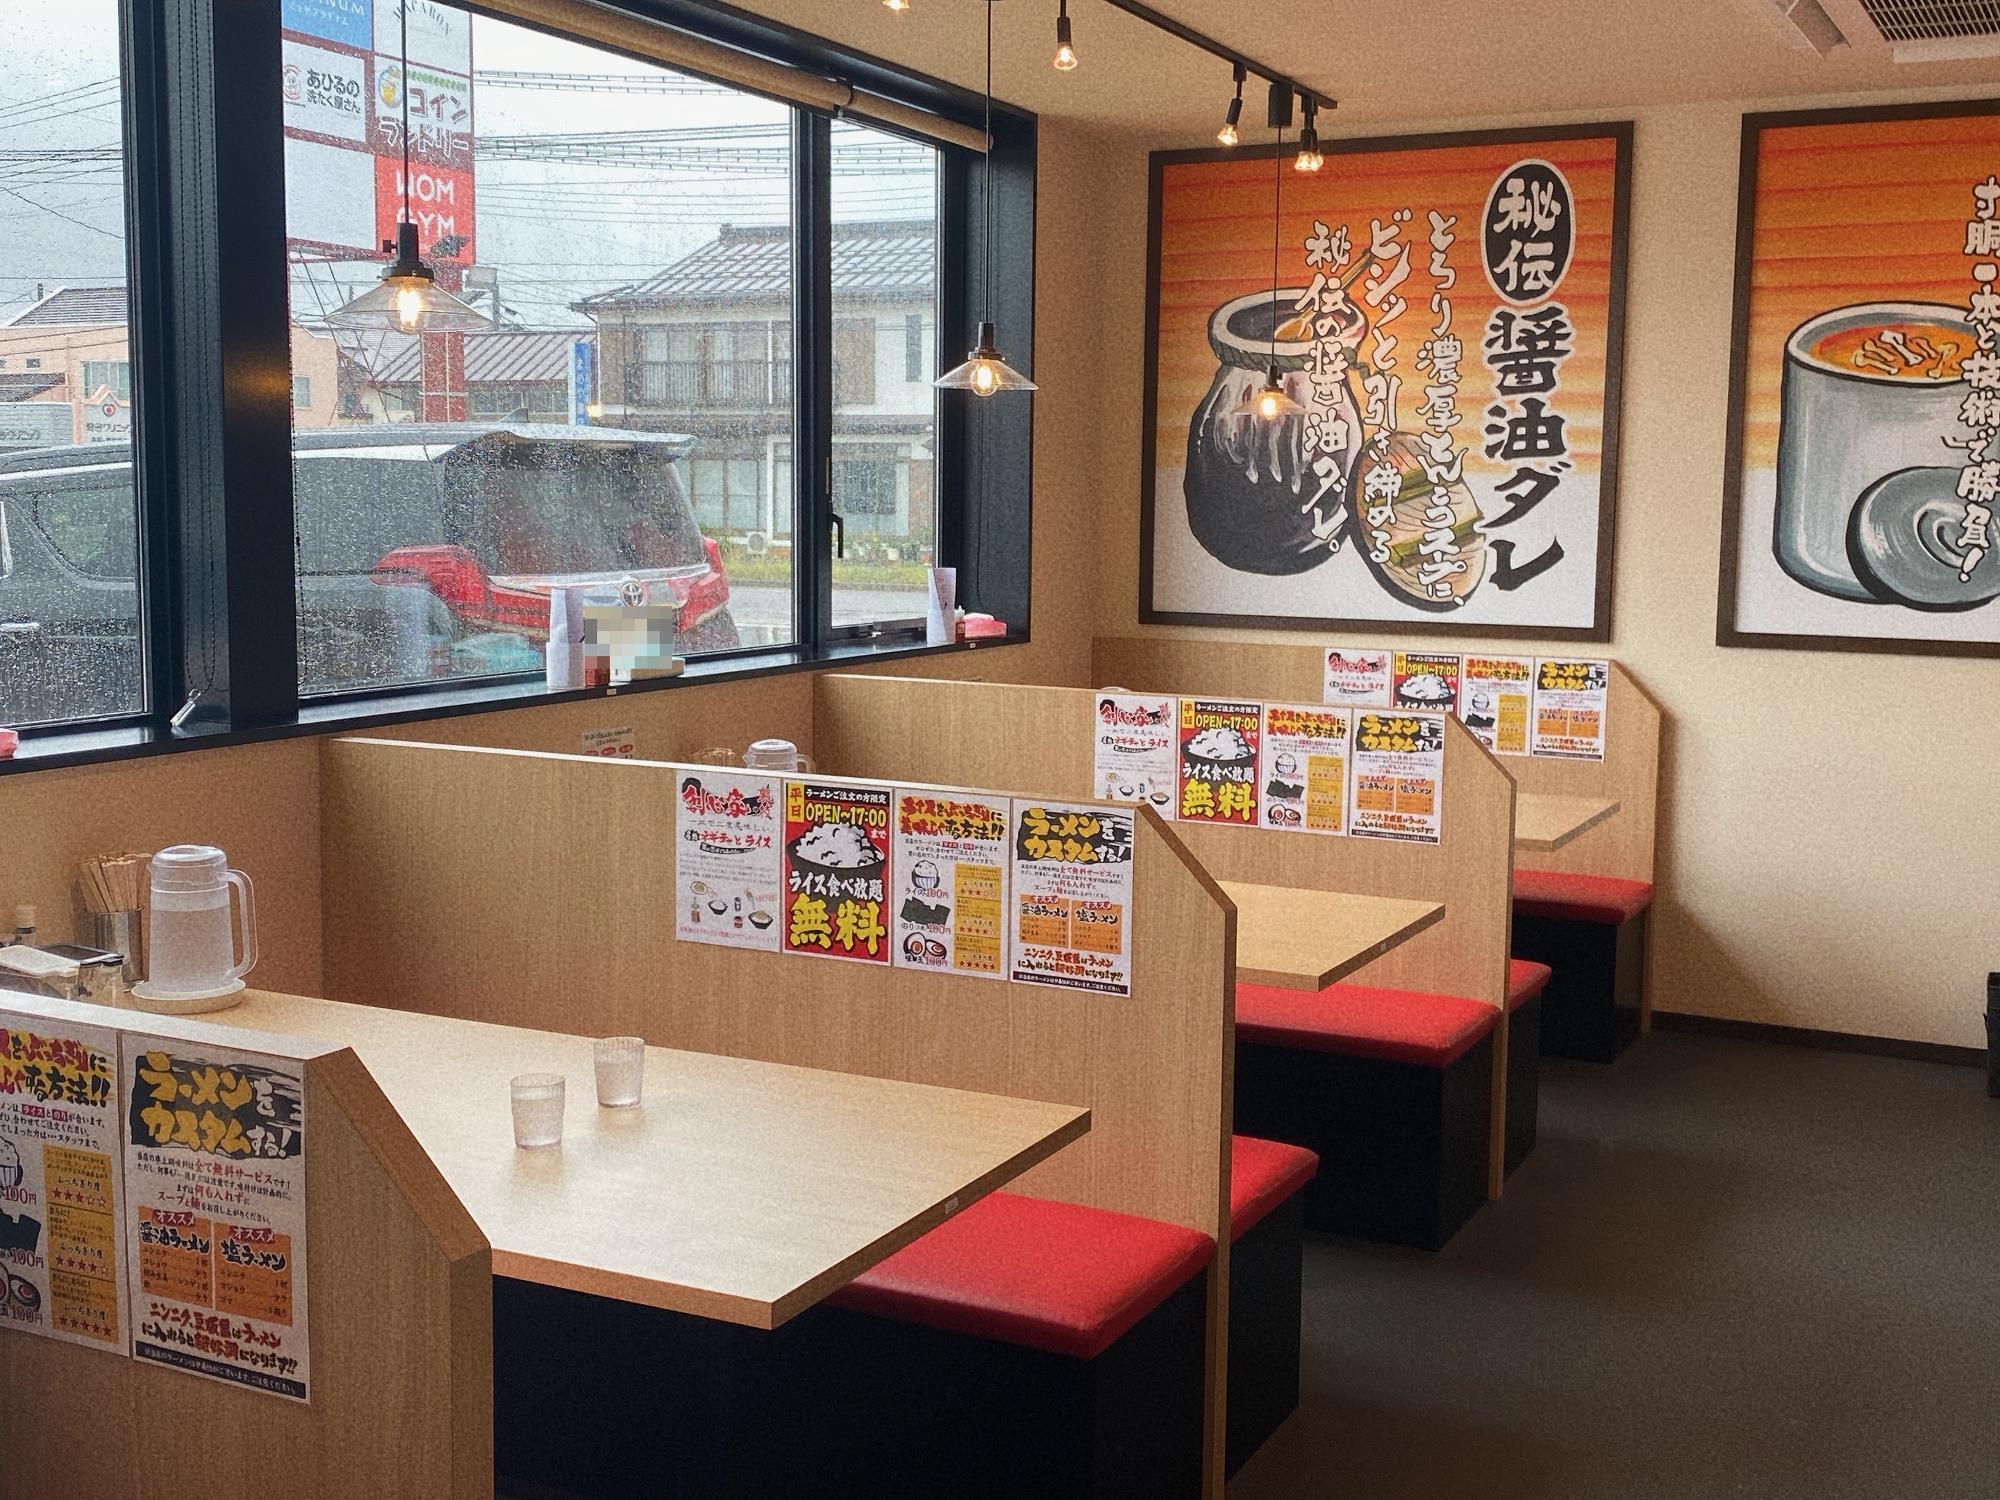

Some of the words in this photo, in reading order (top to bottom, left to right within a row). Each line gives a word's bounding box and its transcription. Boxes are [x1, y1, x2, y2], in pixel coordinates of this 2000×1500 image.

[307, 69, 360, 97] あひるの
[408, 86, 468, 124] コイン
[379, 116, 469, 157] ランドリー
[1295, 220, 1353, 554] 秘伝の醤油ダレ。
[1363, 208, 1412, 564] ビシッと引き締める
[1484, 176, 1574, 594] 秘伝醤油ダレ
[1416, 210, 1469, 606] とろり濃厚とんこつスープに、
[1183, 703, 1193, 725] 平日
[1196, 714, 1258, 730] OPEN~17:00
[1361, 714, 1430, 737] ラーメンを
[1361, 733, 1438, 752] カスタムする!
[1182, 762, 1255, 784] ライス食べ放題
[790, 787, 802, 817] 平日
[806, 788, 887, 804] ラーメンご注文の方限定
[1182, 778, 1256, 821] 無料
[806, 802, 887, 828] OPEN~17:00
[1023, 808, 1115, 840] ラーメンを
[871, 828, 887, 839] まで
[1023, 835, 1126, 863] カスタムする!
[789, 870, 884, 902] ライス食べ放題
[789, 893, 886, 955] 無料
[1075, 908, 1119, 925] 塩ラーメン
[138, 1050, 276, 1118] ラーメンを
[139, 1101, 292, 1158] カスタムする!
[137, 1151, 291, 1190] 当店の卓上調味料は全て無料サービスです!
[157, 1190, 272, 1225] スープと麺をお召し上がりください。
[176, 1183, 251, 1206] まずは何も入れずに
[156, 1210, 195, 1226] オススメ
[233, 1227, 274, 1243] オススメ
[140, 1221, 210, 1253] 醤油ラーメン
[220, 1238, 287, 1272] 塩ラーメン
[150, 1302, 281, 1349] ニンニク、豆板醤はラーメン
